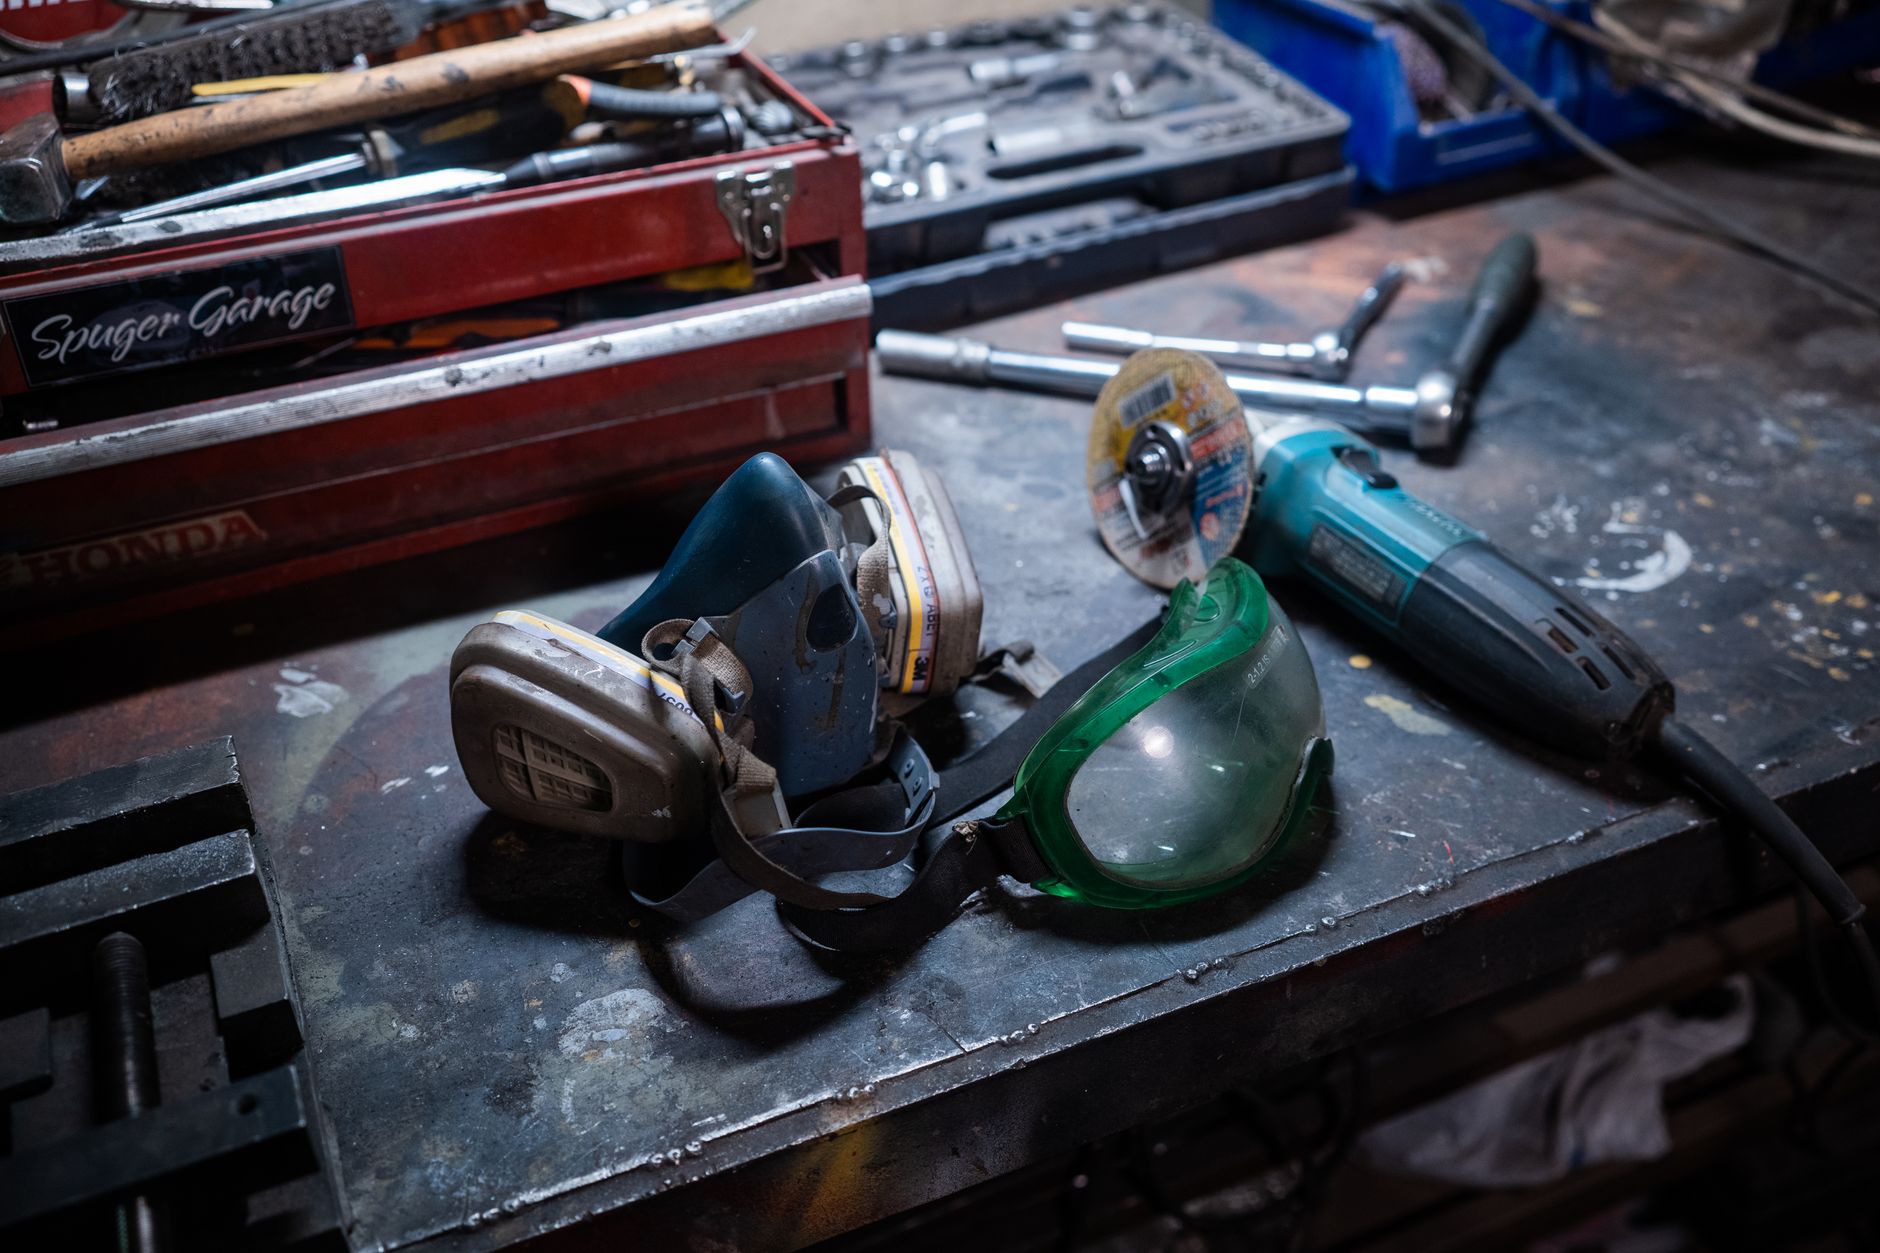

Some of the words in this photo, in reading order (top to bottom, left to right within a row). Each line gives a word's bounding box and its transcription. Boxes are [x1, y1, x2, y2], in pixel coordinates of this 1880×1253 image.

[31, 313, 180, 364] Spuger
[188, 281, 336, 338] Garage
[22, 514, 262, 584] HONDA
[911, 656, 929, 681] 3M
